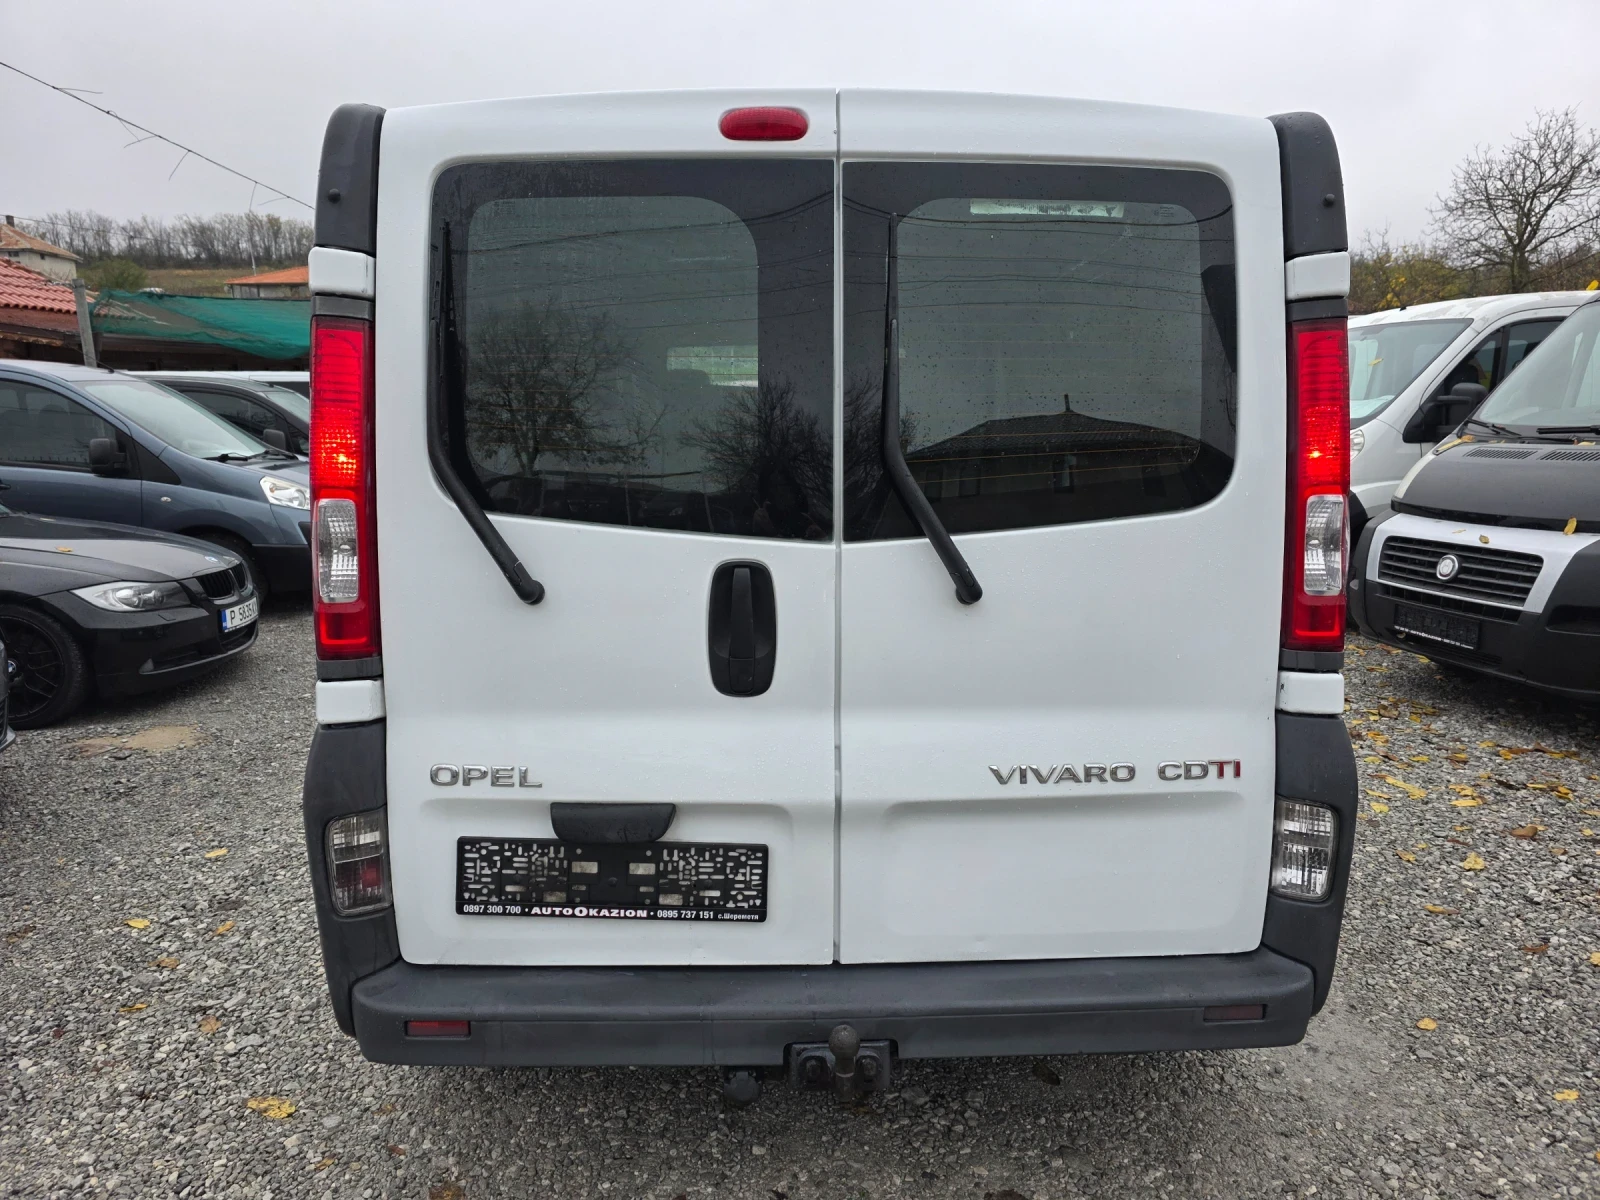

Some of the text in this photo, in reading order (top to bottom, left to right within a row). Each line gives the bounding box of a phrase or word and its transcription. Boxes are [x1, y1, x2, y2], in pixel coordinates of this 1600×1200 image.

[429, 763, 543, 788] OPEL
[988, 759, 1242, 785] VIVARO CDTI
[463, 904, 714, 919] 0897 300 700 AUTOOKAZION 0895 737 151
